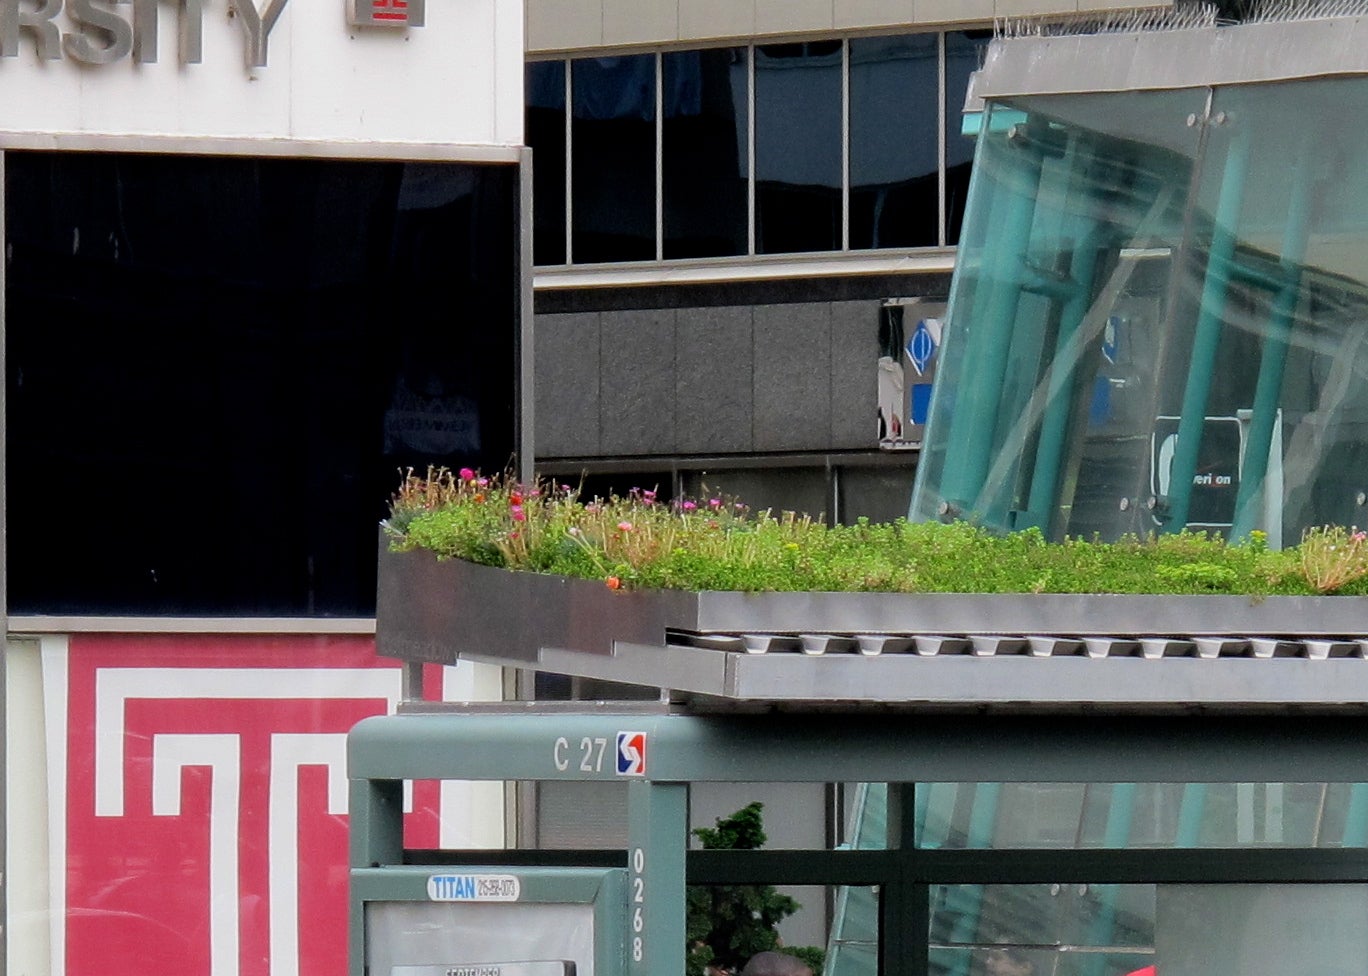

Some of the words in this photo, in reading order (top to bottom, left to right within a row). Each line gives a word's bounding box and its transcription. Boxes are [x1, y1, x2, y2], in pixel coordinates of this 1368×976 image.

[554, 737, 570, 772] C
[580, 737, 608, 773] 27
[432, 876, 476, 899] TITAN
[633, 848, 646, 963] 0268
